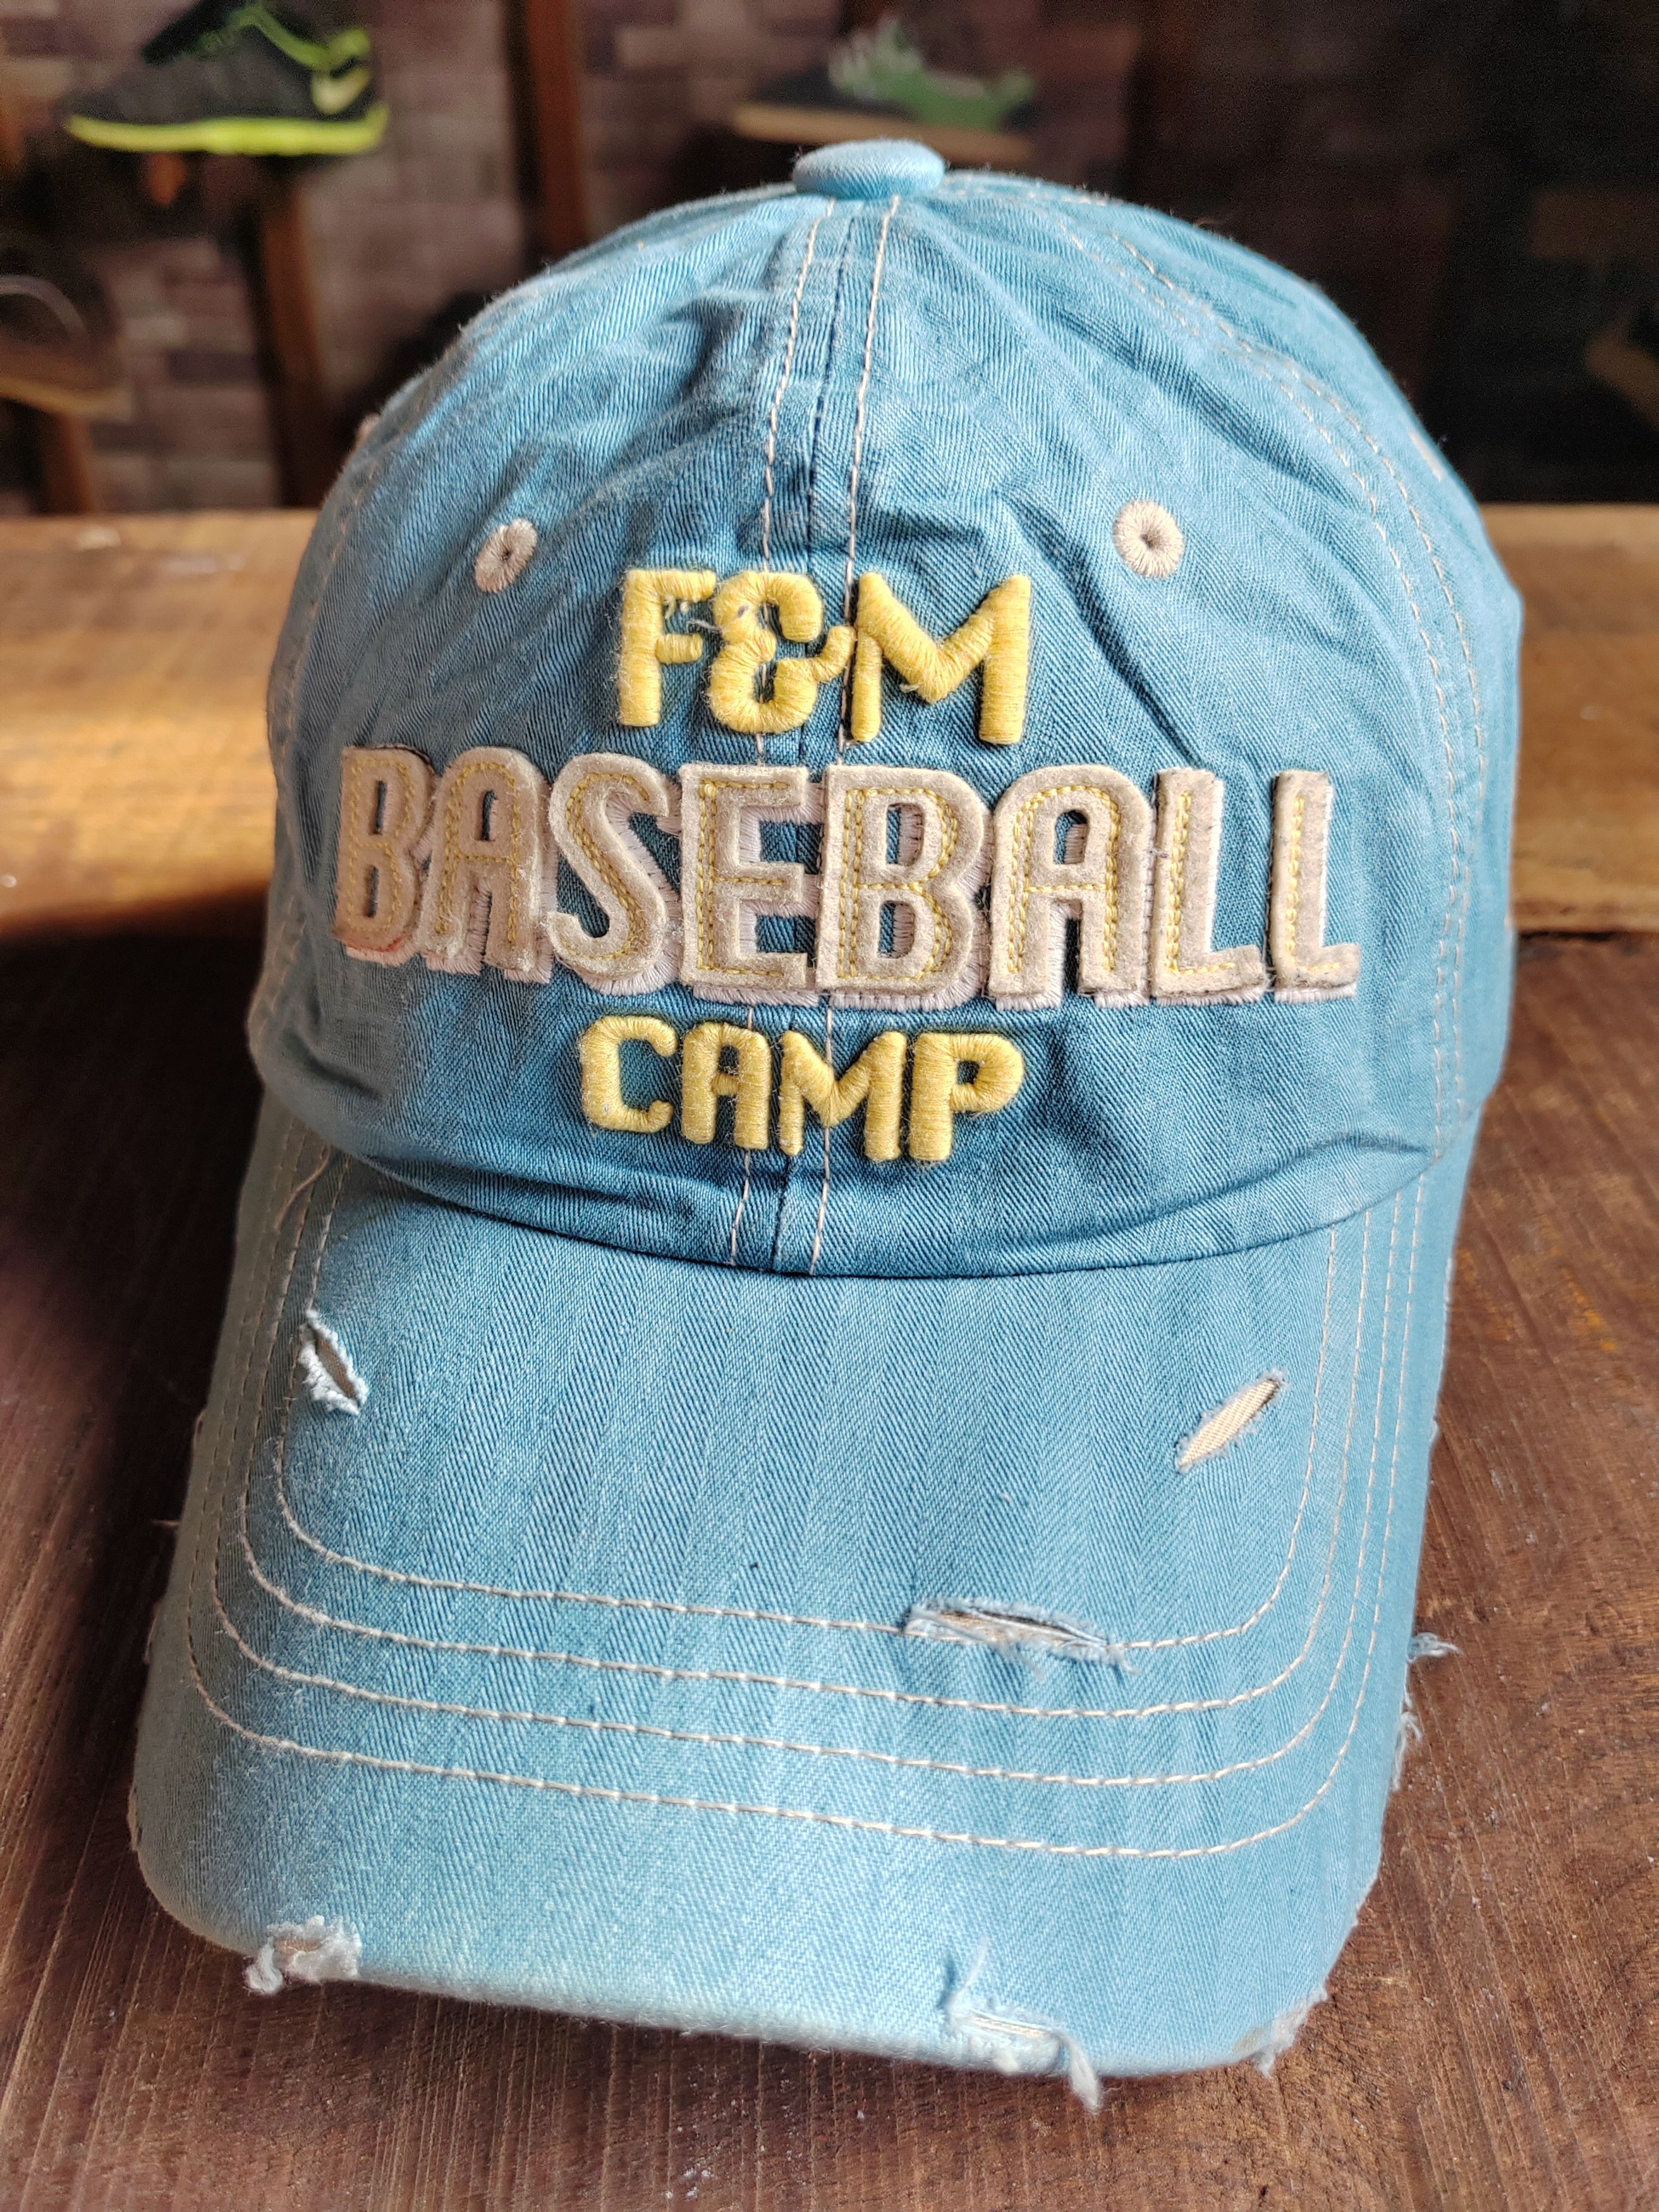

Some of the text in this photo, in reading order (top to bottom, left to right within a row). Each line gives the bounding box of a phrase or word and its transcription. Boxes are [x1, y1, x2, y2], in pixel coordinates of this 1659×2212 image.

[617, 566, 1031, 745] F&M
[337, 744, 1360, 1011] BASEBALL
[579, 1014, 1024, 1162] CAMP
